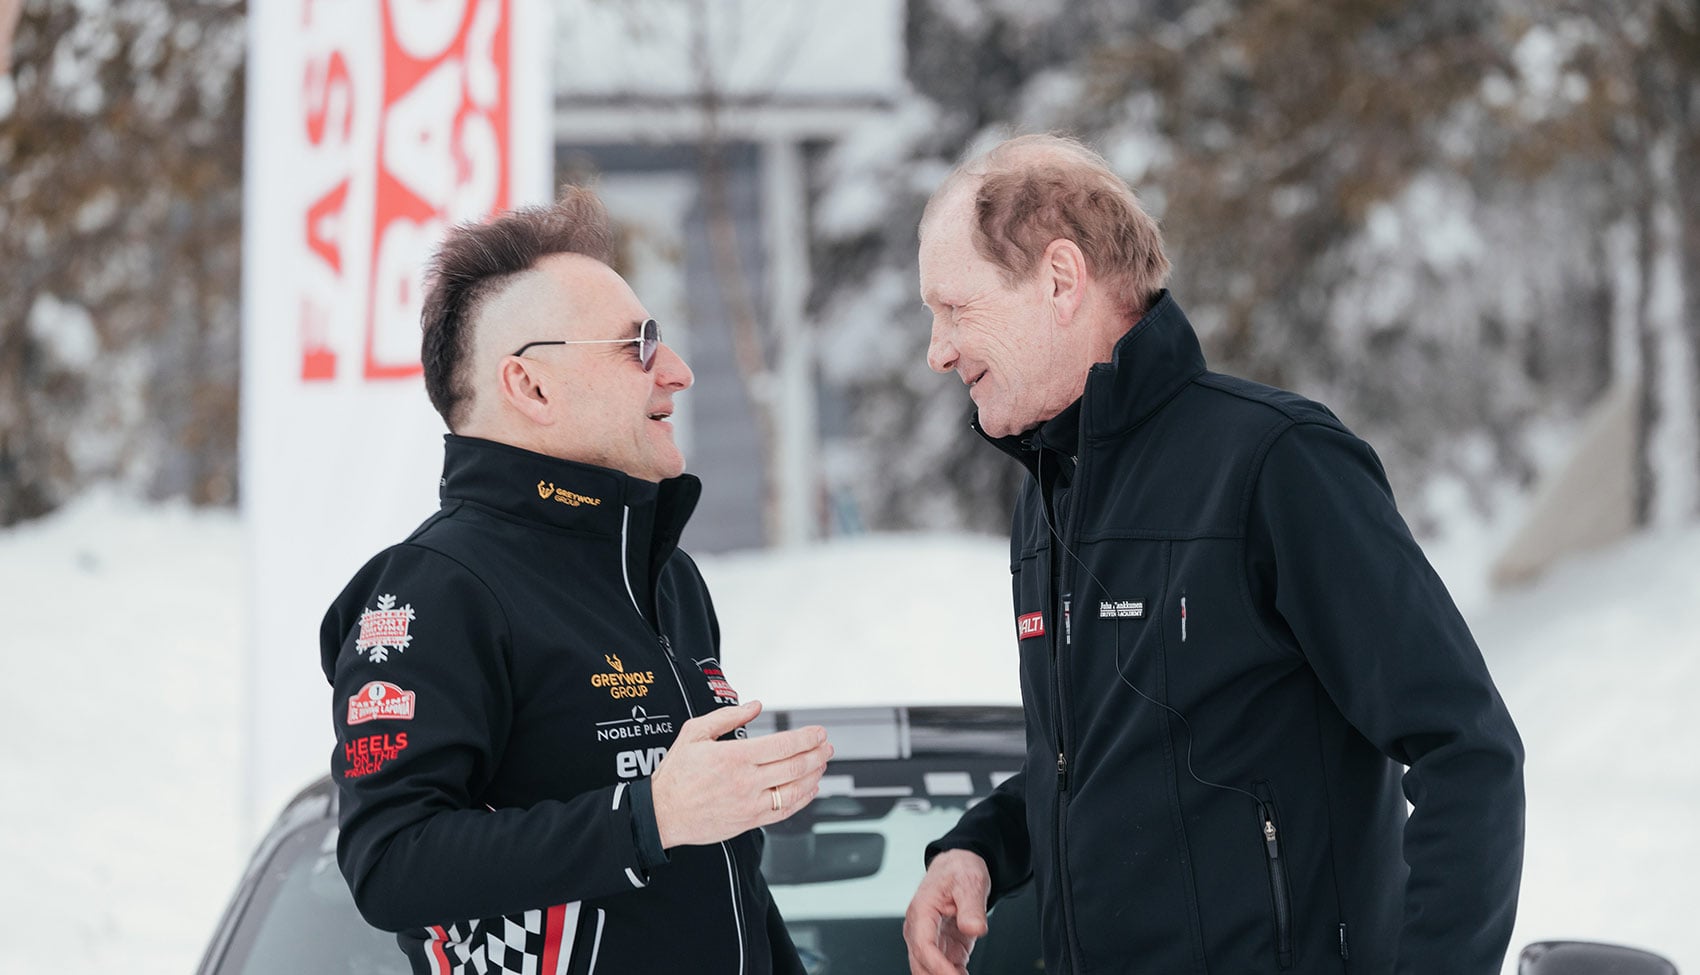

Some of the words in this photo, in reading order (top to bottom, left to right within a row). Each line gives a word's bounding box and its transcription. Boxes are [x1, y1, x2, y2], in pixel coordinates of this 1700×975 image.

[556, 487, 602, 506] GREYWOLF
[591, 671, 655, 688] GREYWOLF
[610, 685, 649, 699] GROUP
[597, 725, 642, 742] NOBLE
[643, 722, 673, 736] PLACE
[344, 731, 409, 762] HEELS
